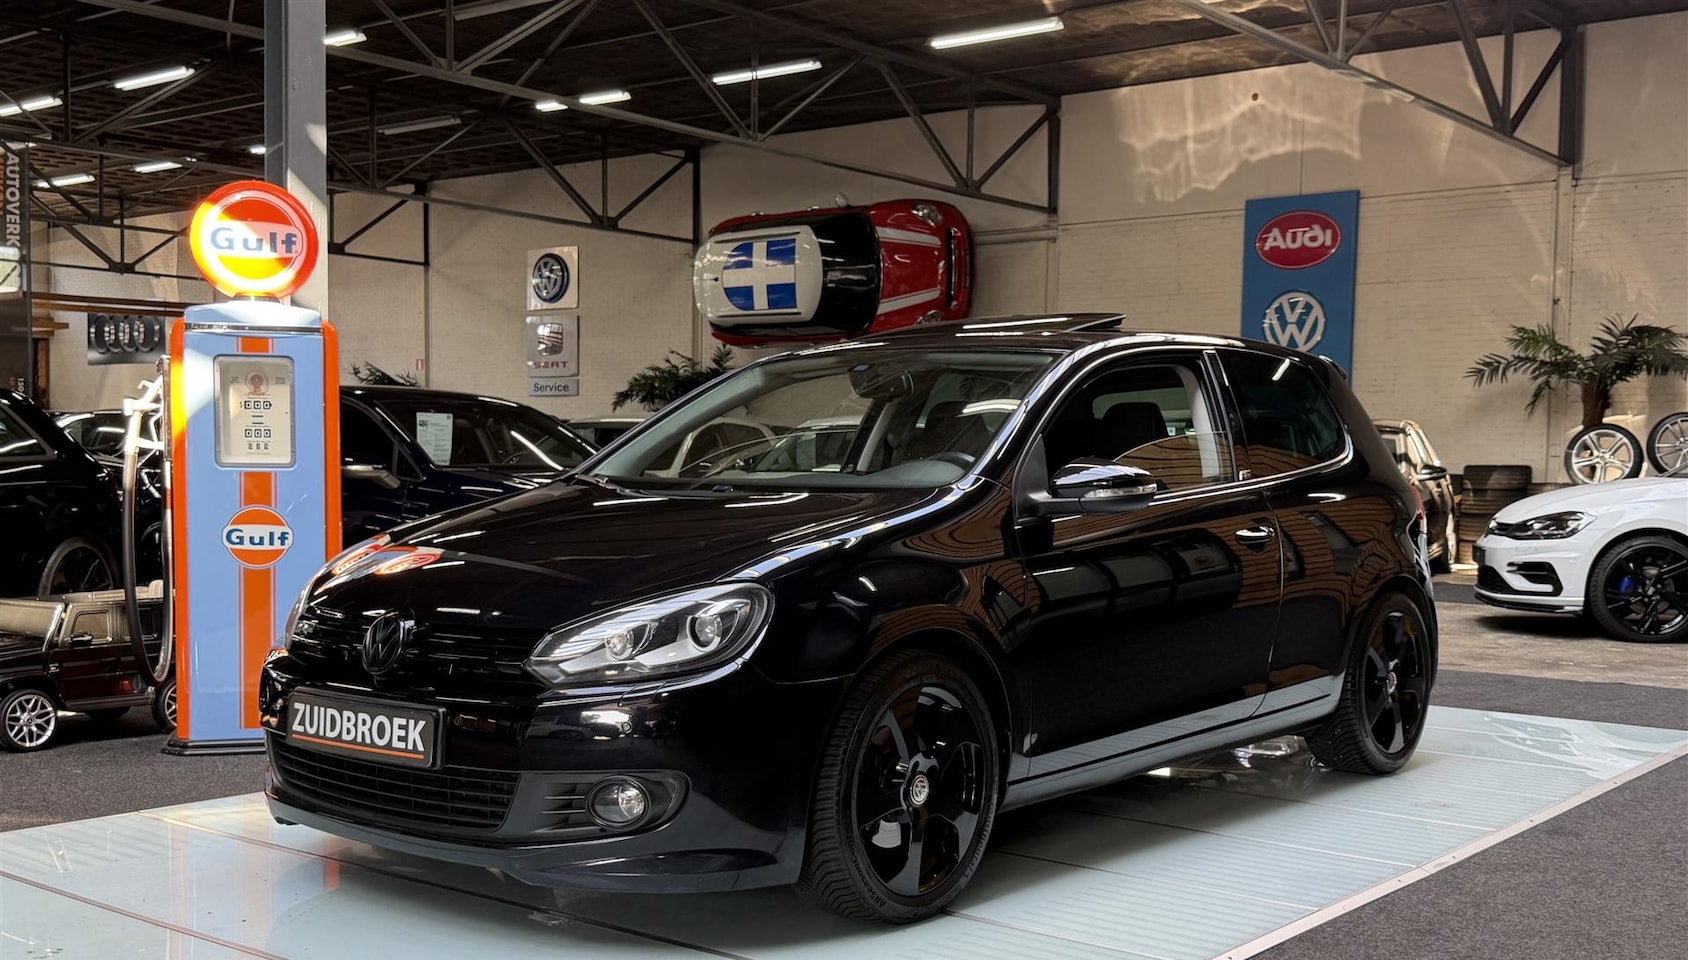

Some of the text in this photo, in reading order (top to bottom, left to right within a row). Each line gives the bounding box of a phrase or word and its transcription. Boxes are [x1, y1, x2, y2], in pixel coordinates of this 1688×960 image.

[210, 227, 297, 254] Gulf
[534, 361, 569, 369] SEAT
[533, 382, 570, 392] Service
[226, 528, 290, 546] Gulf
[292, 702, 427, 752] ZUIDBROEK
